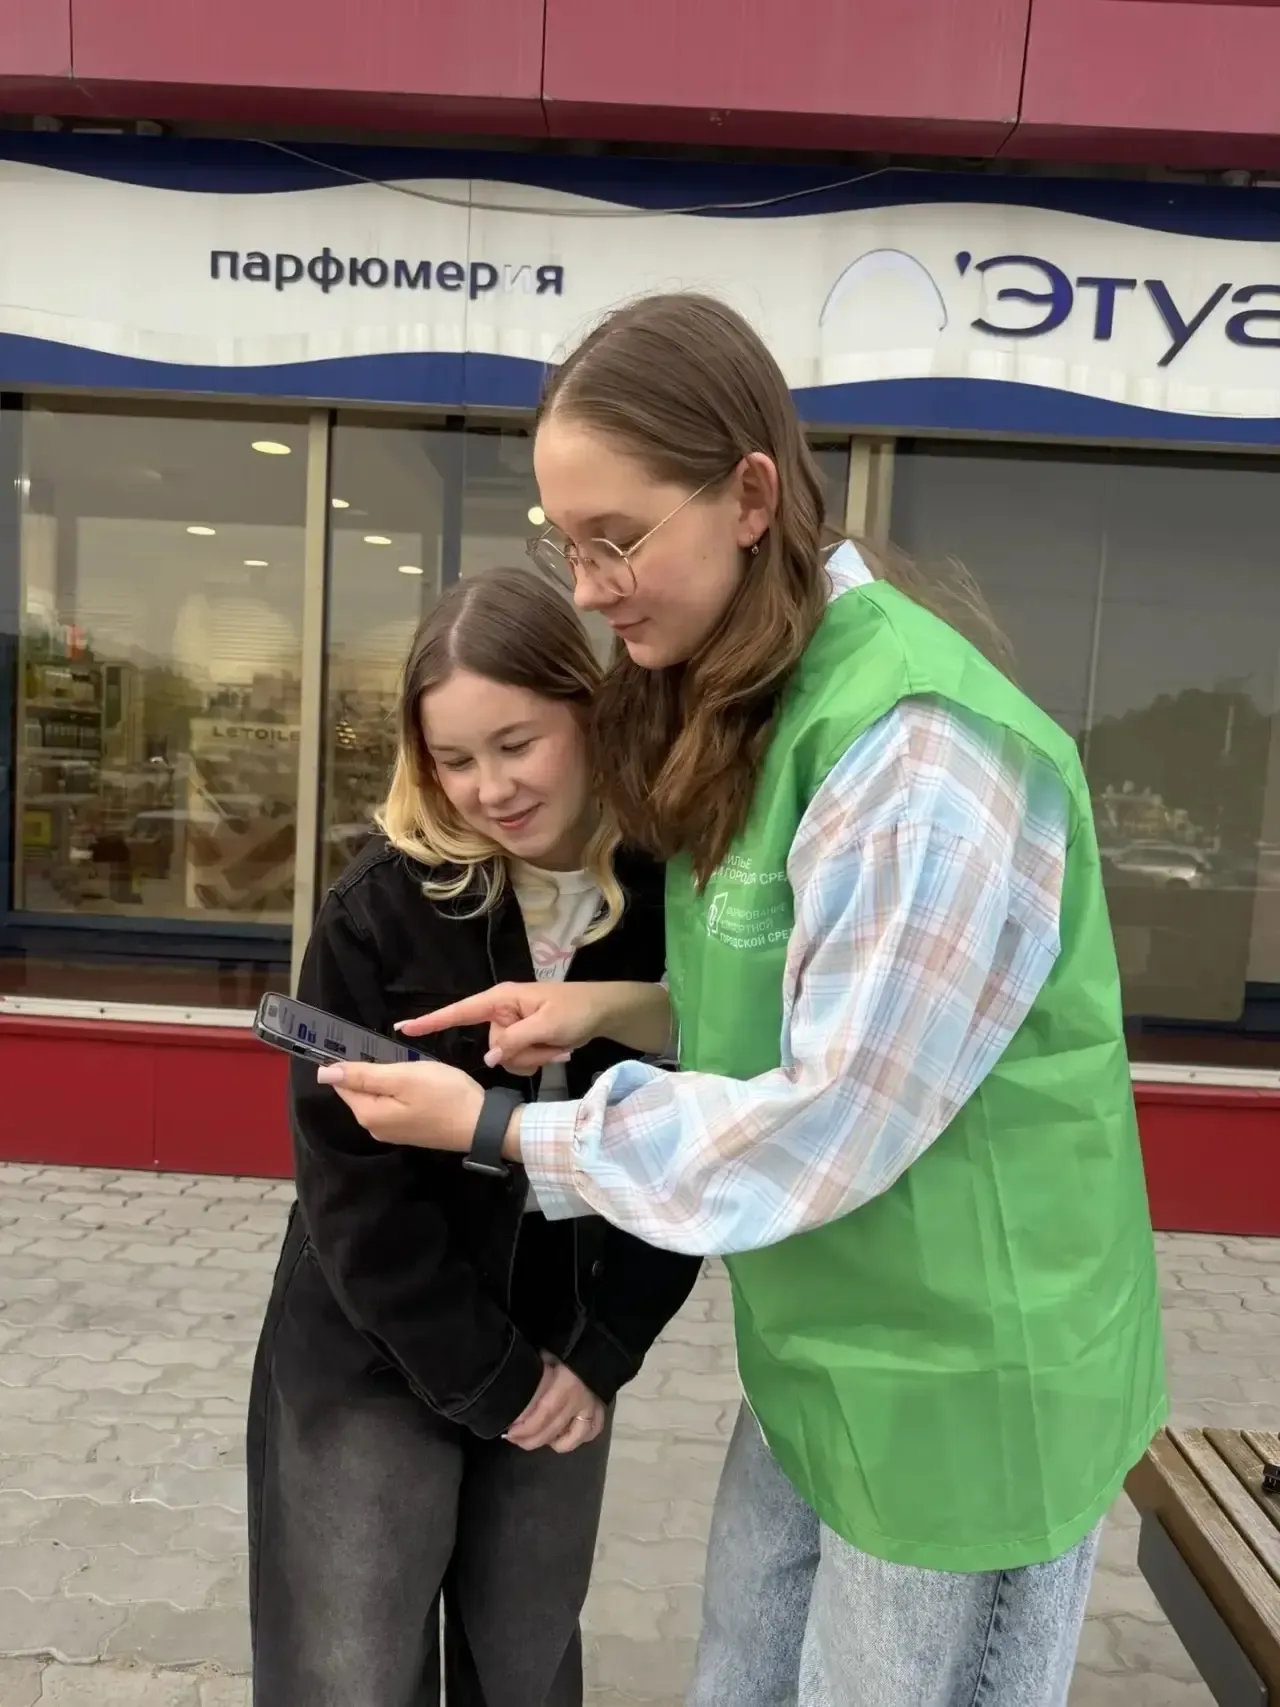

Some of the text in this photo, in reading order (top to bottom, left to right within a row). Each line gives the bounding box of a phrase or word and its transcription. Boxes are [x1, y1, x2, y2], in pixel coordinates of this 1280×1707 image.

[210, 247, 564, 300] парфюмерия
[723, 853, 752, 869] ИЛЬЕ
[759, 871, 788, 885] СРЕ
